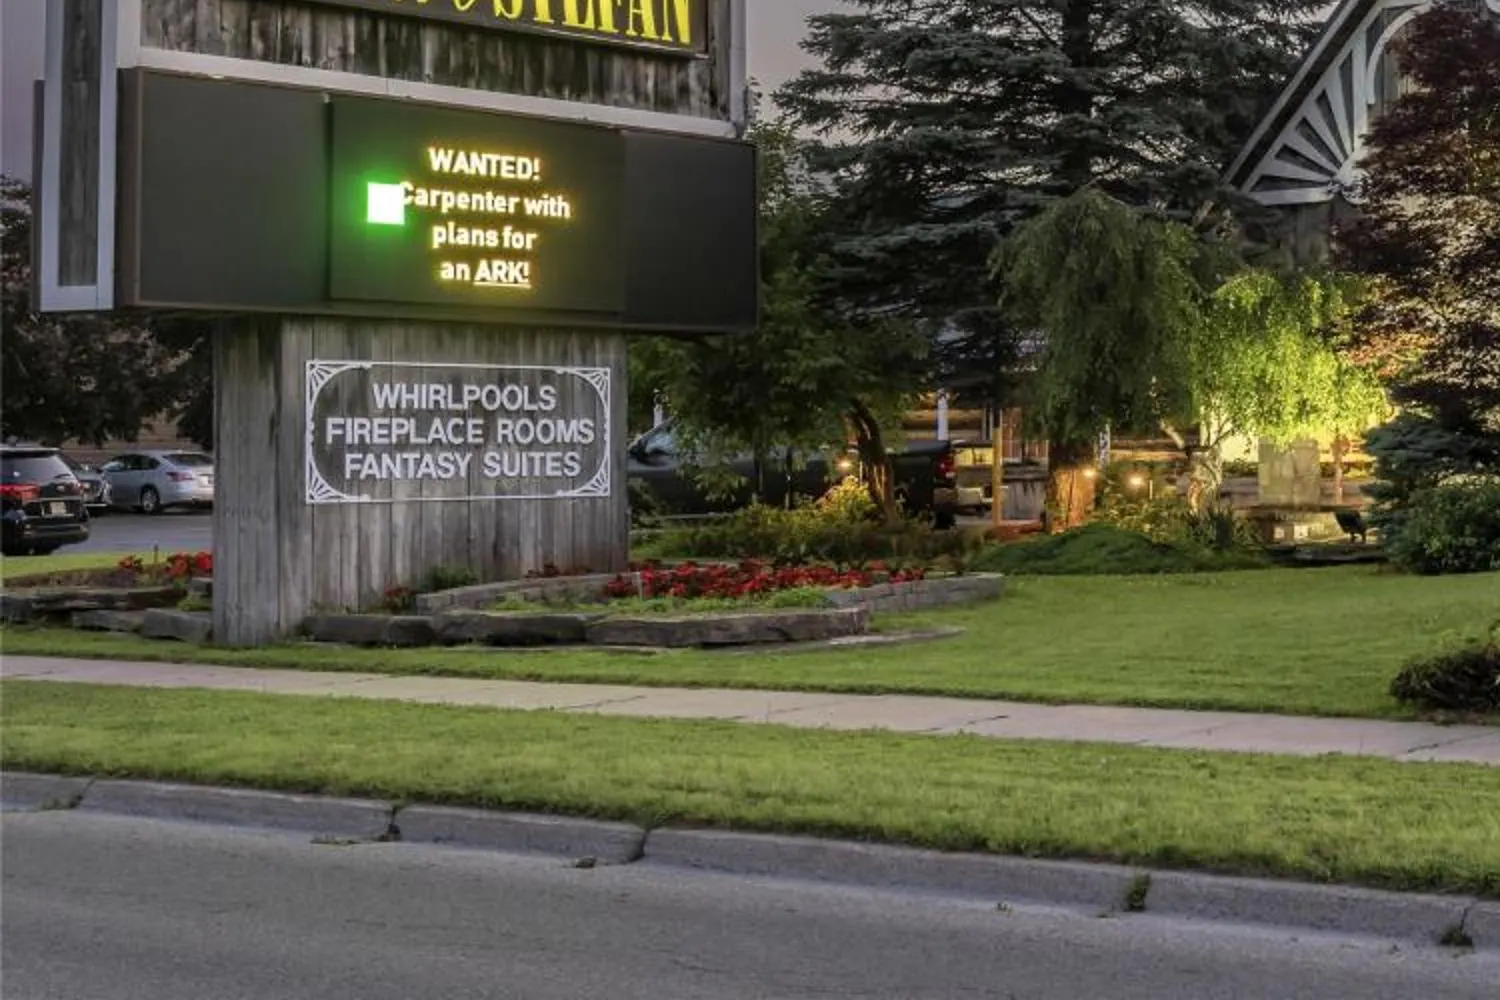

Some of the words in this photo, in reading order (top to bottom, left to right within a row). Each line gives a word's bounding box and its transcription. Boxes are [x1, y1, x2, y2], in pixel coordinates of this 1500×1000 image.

[428, 147, 542, 181] WANTED!
[399, 181, 521, 214] Carpenter
[523, 194, 571, 219] with
[432, 221, 499, 249] plans
[502, 225, 538, 251] for
[440, 261, 471, 281] an
[473, 259, 532, 289] ARK!
[373, 384, 557, 411] WHIRLPOOLS
[325, 417, 485, 445] FIREPLACE
[496, 418, 595, 445] ROOMS
[344, 453, 473, 480] FANTASY
[483, 451, 582, 477] SUITES
